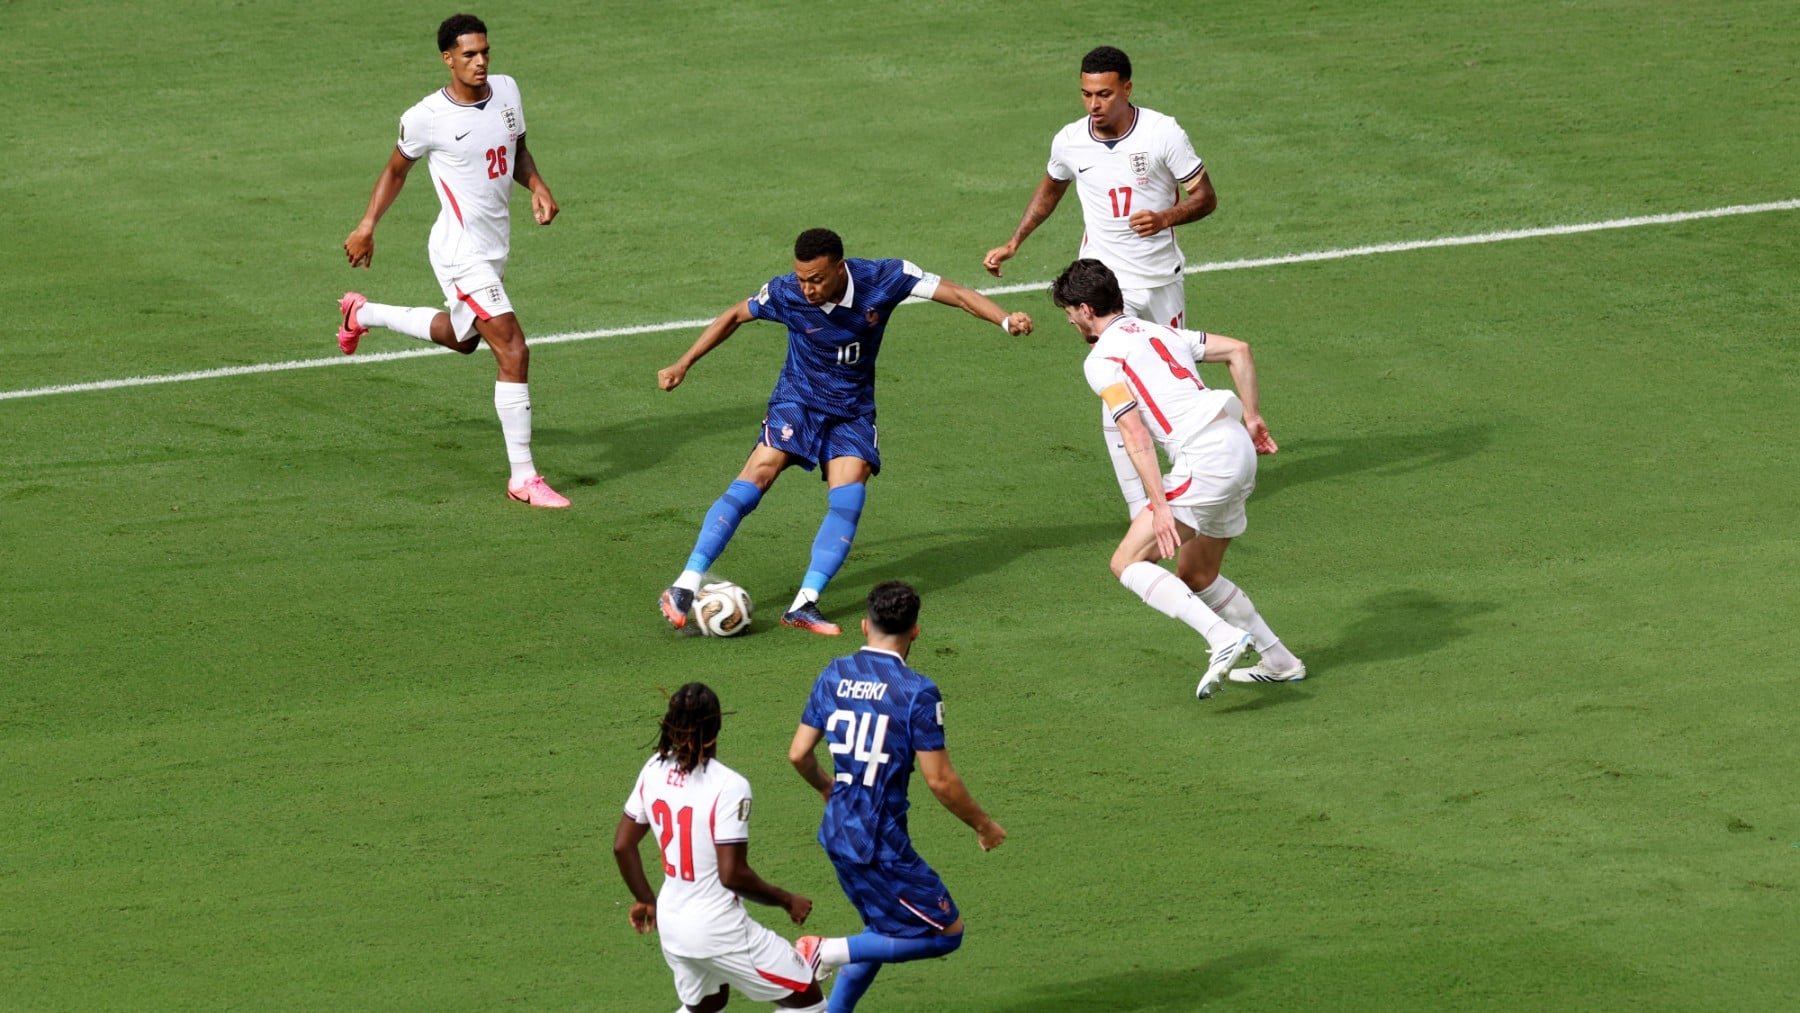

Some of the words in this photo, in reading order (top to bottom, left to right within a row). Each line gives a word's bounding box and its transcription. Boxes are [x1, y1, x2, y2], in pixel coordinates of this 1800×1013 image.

[486, 145, 508, 180] 26
[1108, 186, 1132, 218] 17
[836, 341, 860, 365] 10
[1149, 336, 1205, 391] 4
[836, 678, 888, 701] CHERKI
[826, 708, 890, 787] 24
[666, 768, 688, 788] EZE
[651, 798, 696, 882] 21
